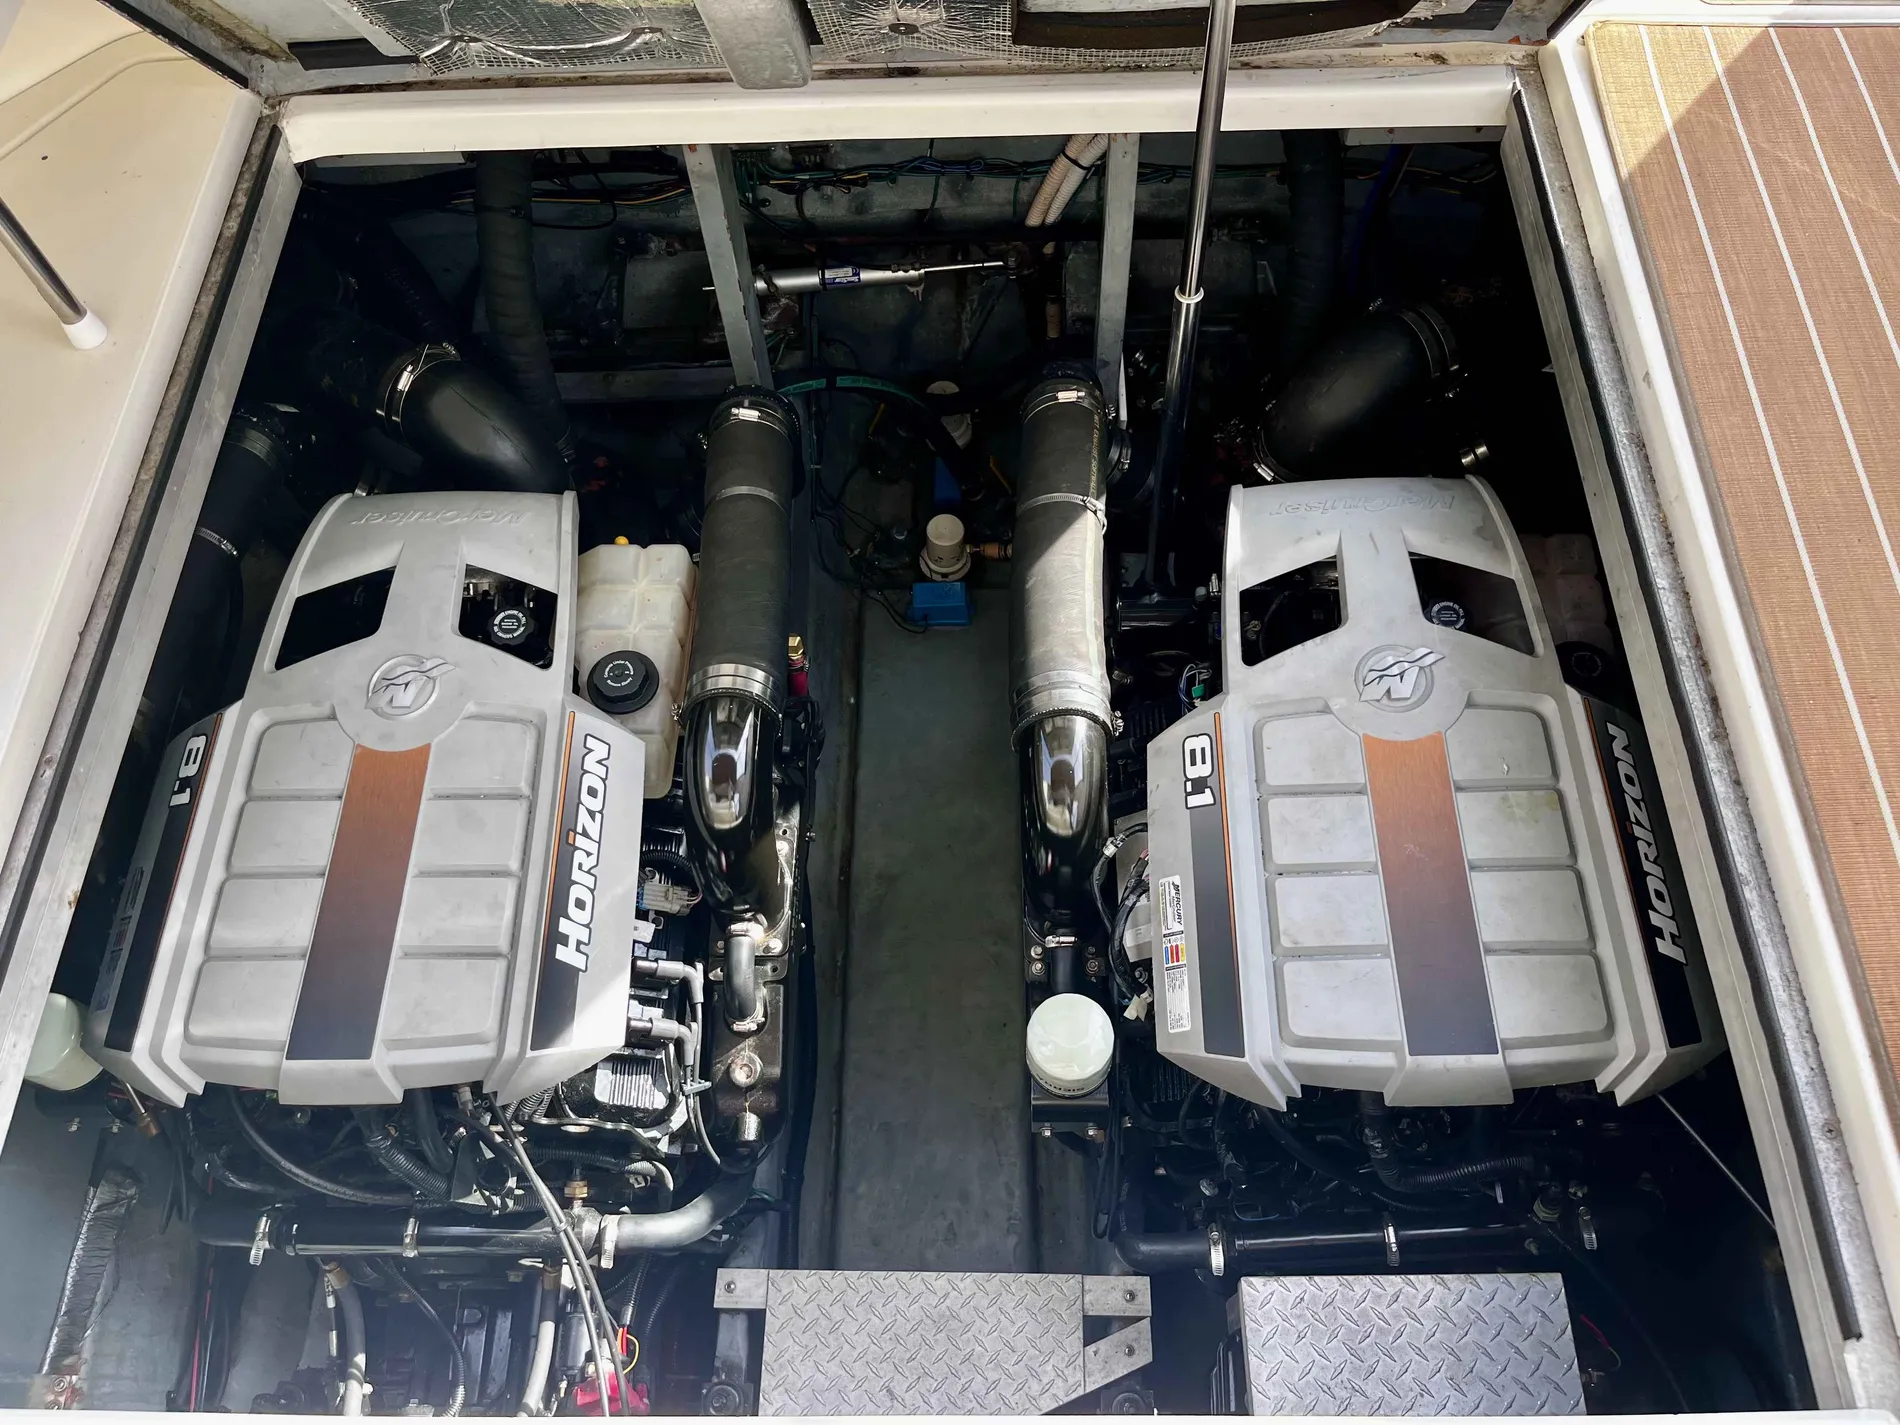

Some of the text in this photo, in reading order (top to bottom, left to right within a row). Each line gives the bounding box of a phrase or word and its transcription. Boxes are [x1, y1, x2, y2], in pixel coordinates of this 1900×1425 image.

[349, 509, 529, 527] MerCruiser
[1269, 495, 1455, 516] MerCruiser
[169, 734, 208, 807] 8.1
[1182, 733, 1216, 810] 8.1
[1172, 881, 1182, 925] MERCURY
